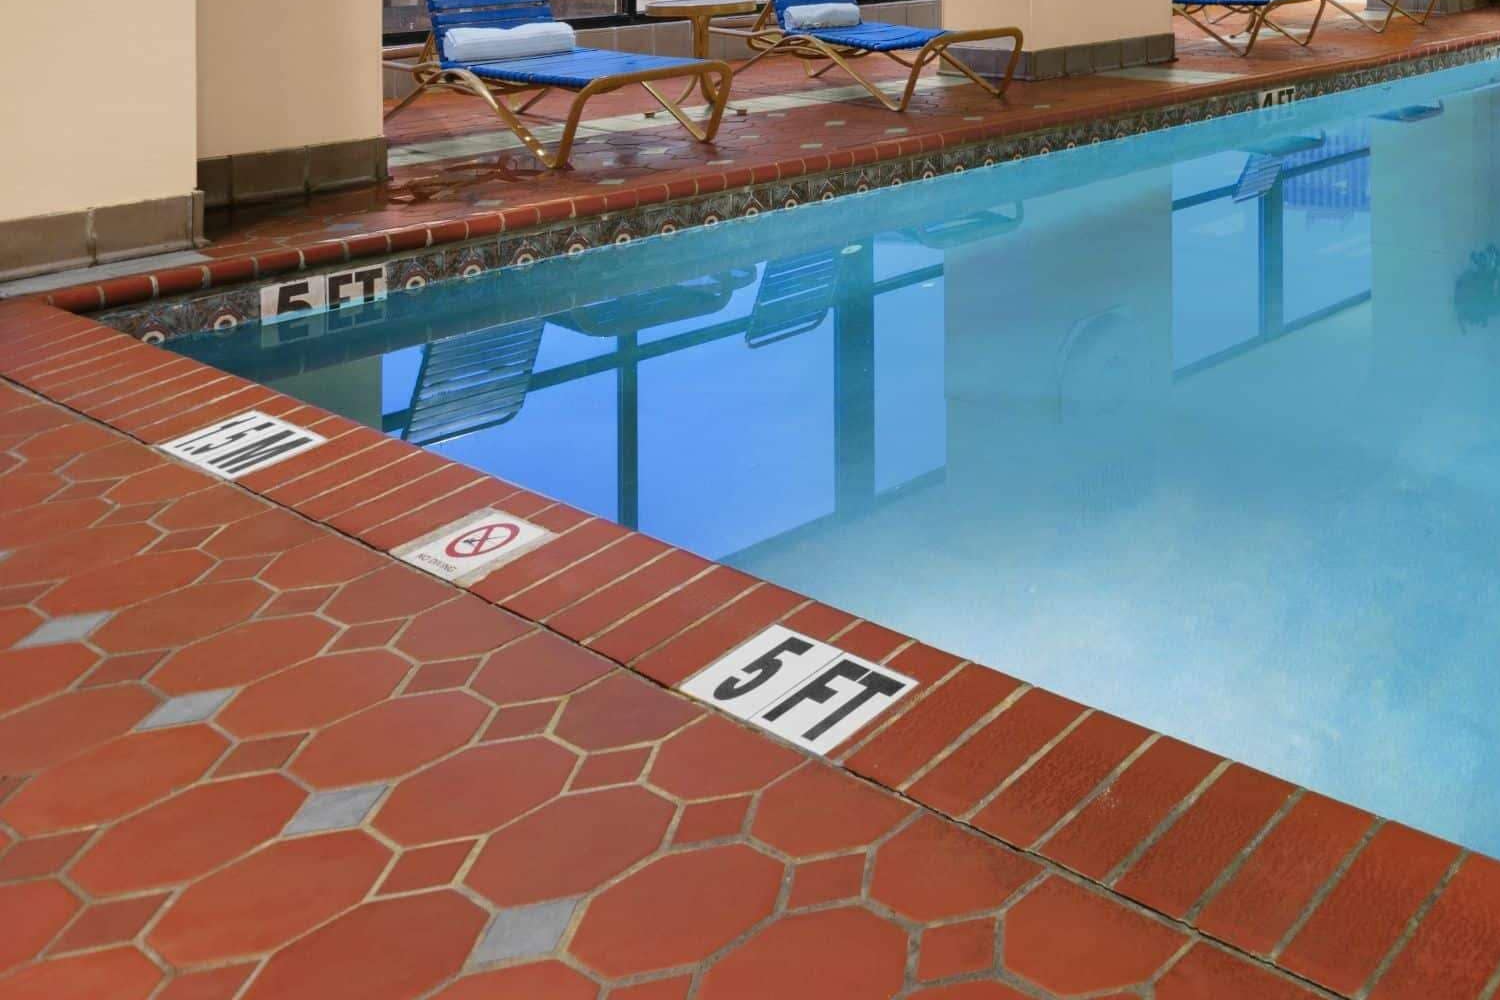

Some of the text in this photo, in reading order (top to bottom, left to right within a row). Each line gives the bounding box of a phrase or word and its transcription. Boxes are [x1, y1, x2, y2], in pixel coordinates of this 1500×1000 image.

[329, 268, 383, 310] FT
[713, 636, 907, 742] 5 FT
